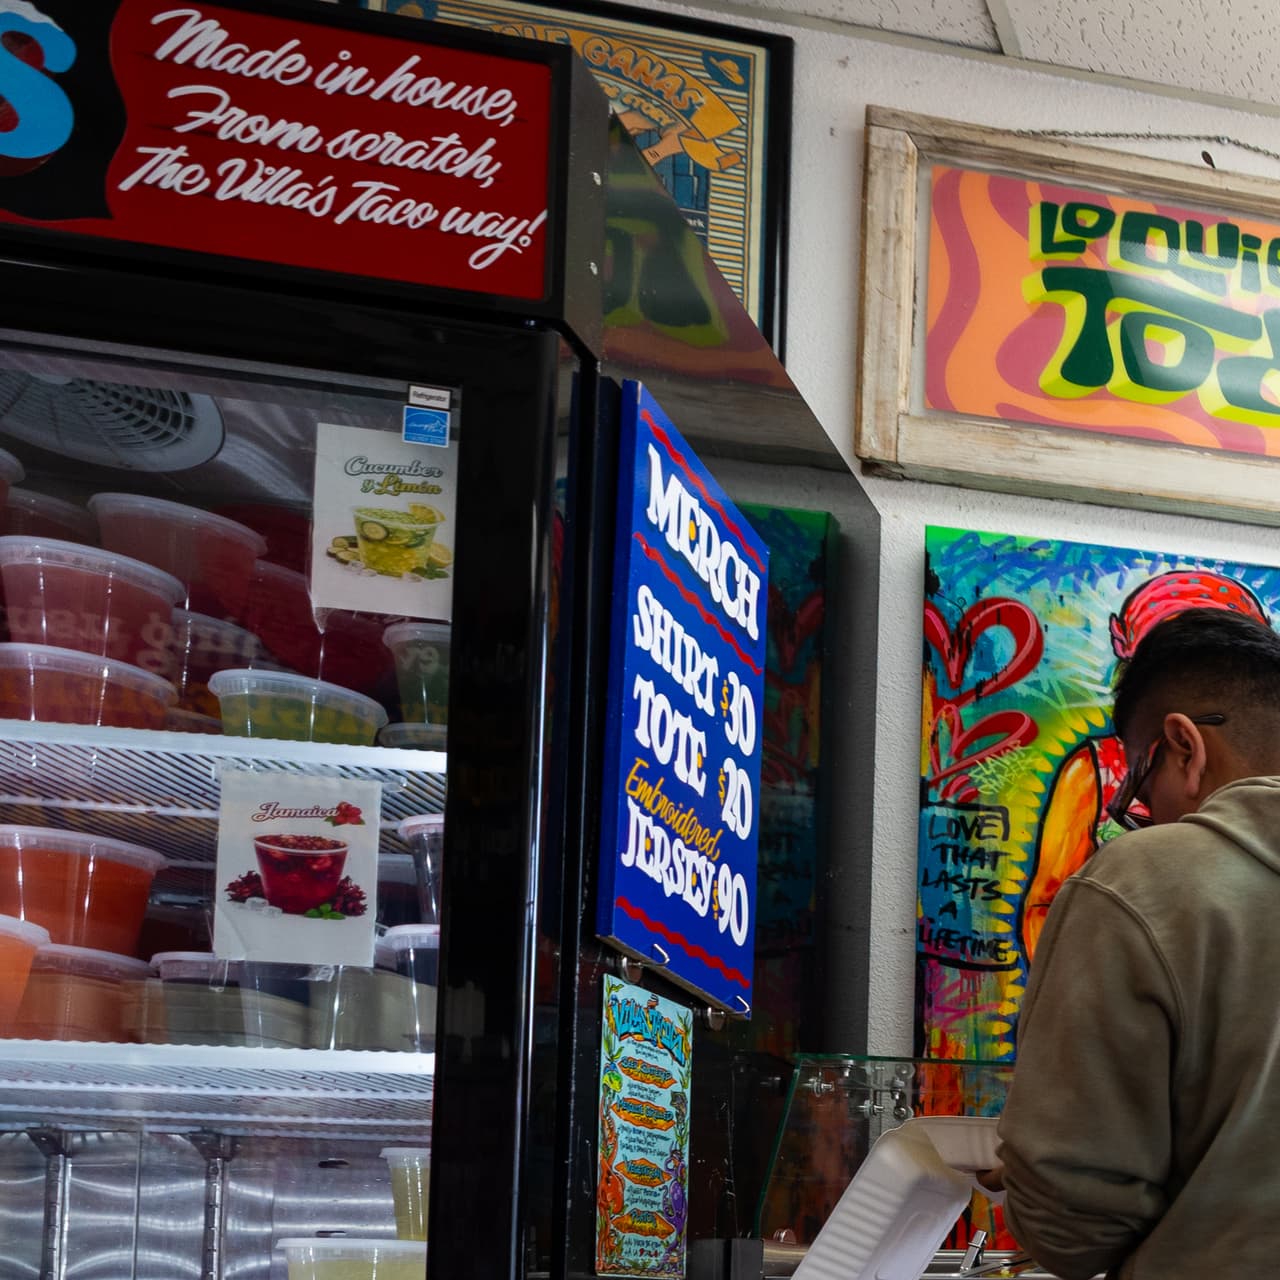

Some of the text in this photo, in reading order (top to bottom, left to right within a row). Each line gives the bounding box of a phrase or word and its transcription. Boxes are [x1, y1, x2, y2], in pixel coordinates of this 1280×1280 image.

[151, 9, 312, 87] Made
[314, 50, 375, 97] in
[374, 54, 520, 129] house,
[583, 36, 706, 111] GANAS
[167, 86, 504, 189] From scratch,
[118, 145, 549, 271] The Villa's Taco way!
[345, 456, 443, 479] Cucumber
[361, 474, 443, 496] y Limón
[647, 443, 760, 640] MERCH
[633, 584, 756, 757] SHIRT $30
[633, 674, 753, 841] TOTE $20
[252, 801, 340, 822] Jamaica
[625, 757, 722, 861] Embroidered
[928, 814, 1001, 842] LOVE
[621, 795, 749, 946] JERSEY $90
[921, 868, 1002, 901] LASTS
[932, 844, 1014, 871] THAT
[919, 926, 1009, 962] LIFETIME
[938, 901, 958, 920] A
